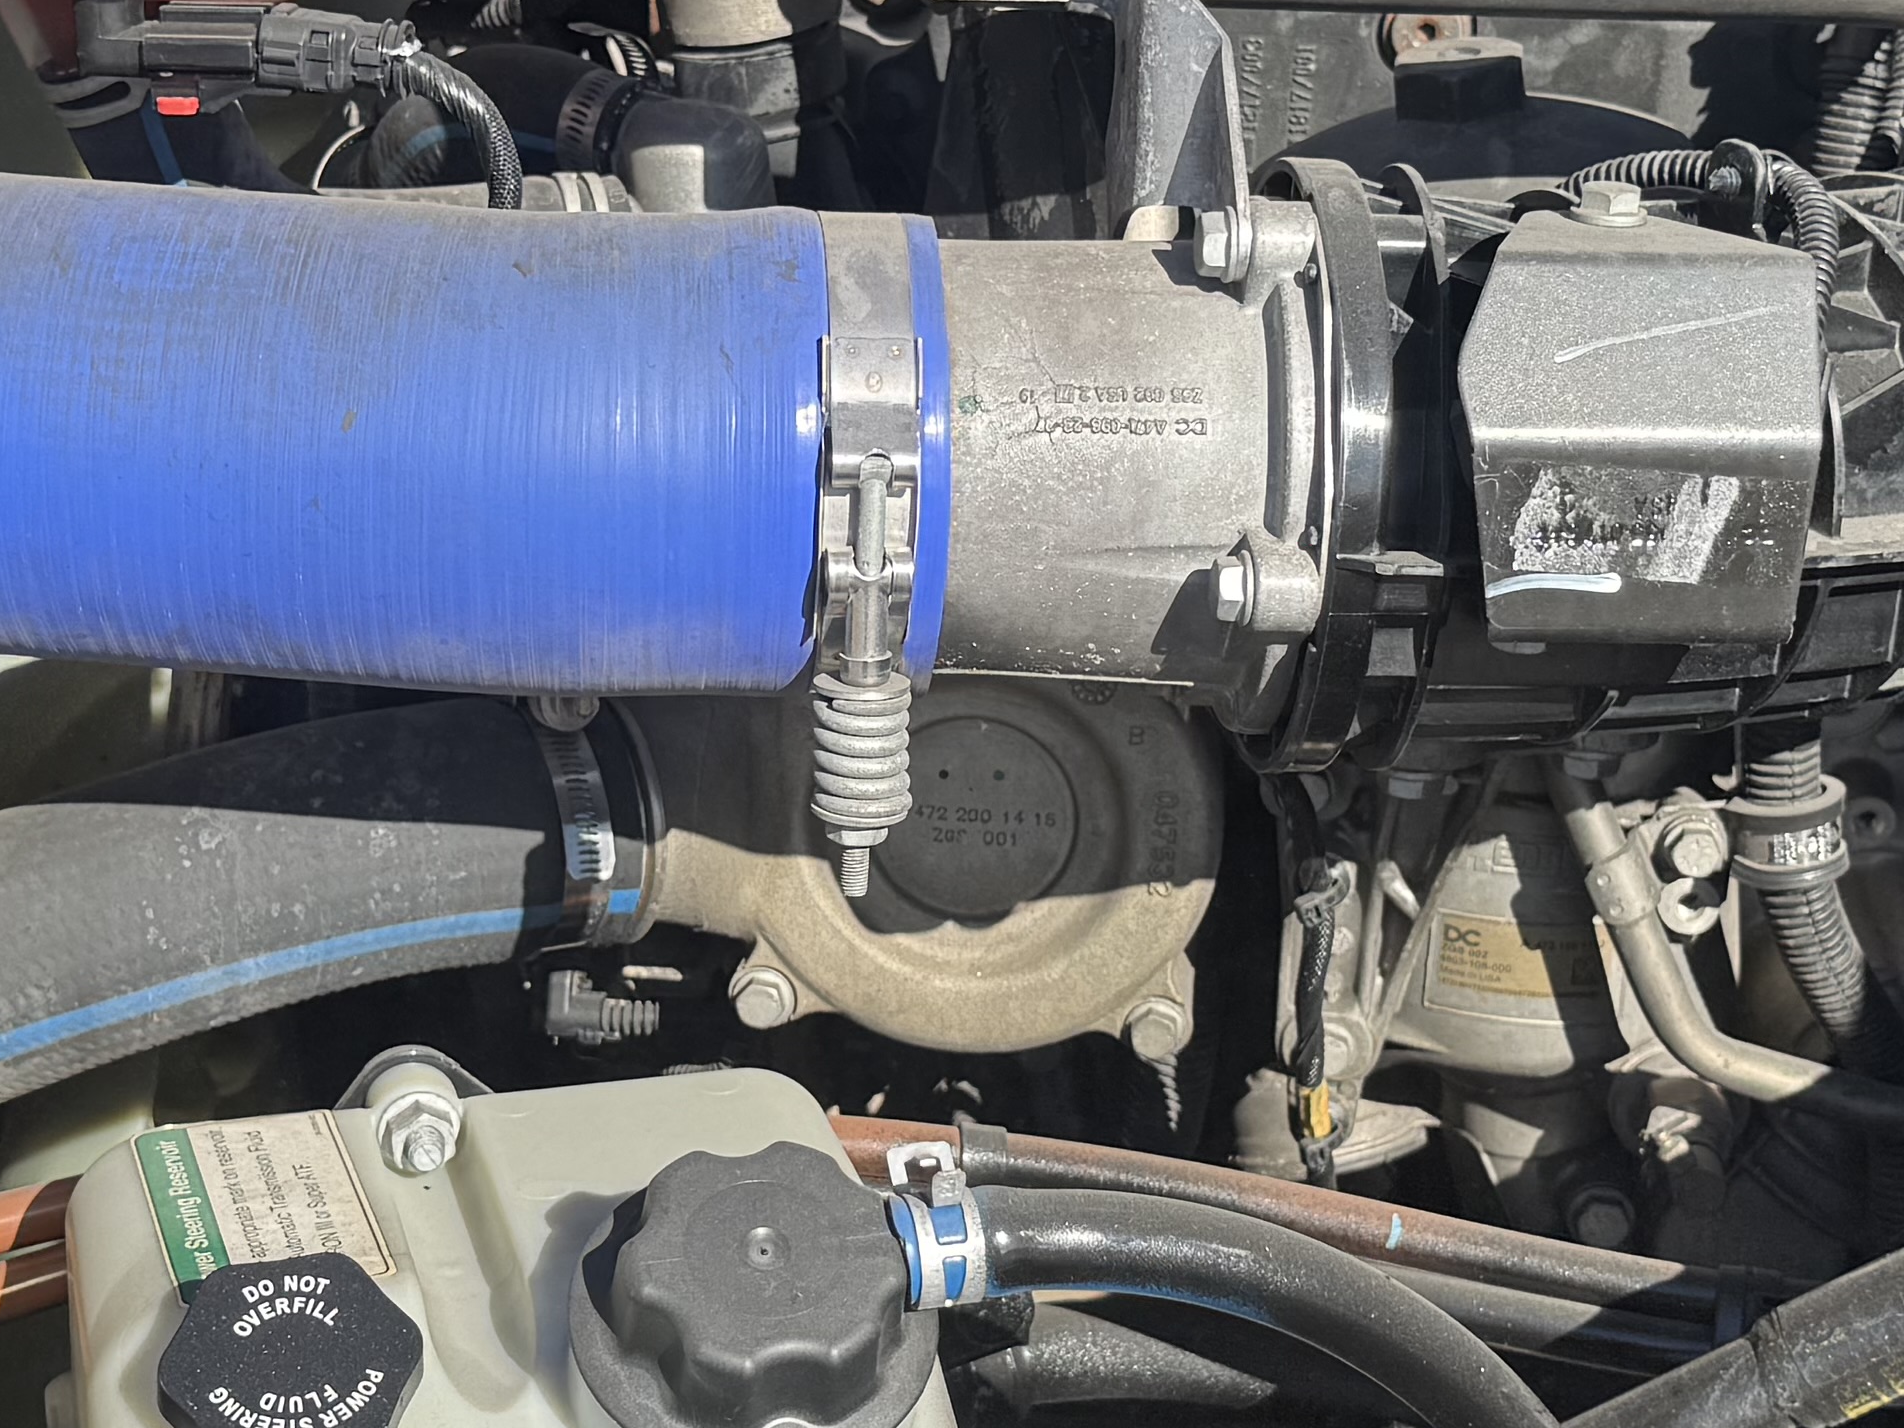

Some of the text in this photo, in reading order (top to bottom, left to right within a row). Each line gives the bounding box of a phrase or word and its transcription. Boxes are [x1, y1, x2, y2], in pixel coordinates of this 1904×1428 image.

[1174, 418, 1207, 435] DC
[984, 831, 1017, 846] 001
[1443, 924, 1481, 947] DC
[218, 1168, 237, 1180] on
[156, 1140, 209, 1249] Steering Reservoir
[221, 1181, 247, 1204] mark
[245, 1130, 307, 1259] Automatic Transmission Fluid
[301, 1181, 330, 1218] or Super
[233, 1206, 267, 1259] appropriate
[242, 1275, 331, 1303] DO NOT
[233, 1297, 339, 1336] OVERFILL
[259, 1384, 339, 1413] FLUID
[318, 1369, 385, 1428] POWER
